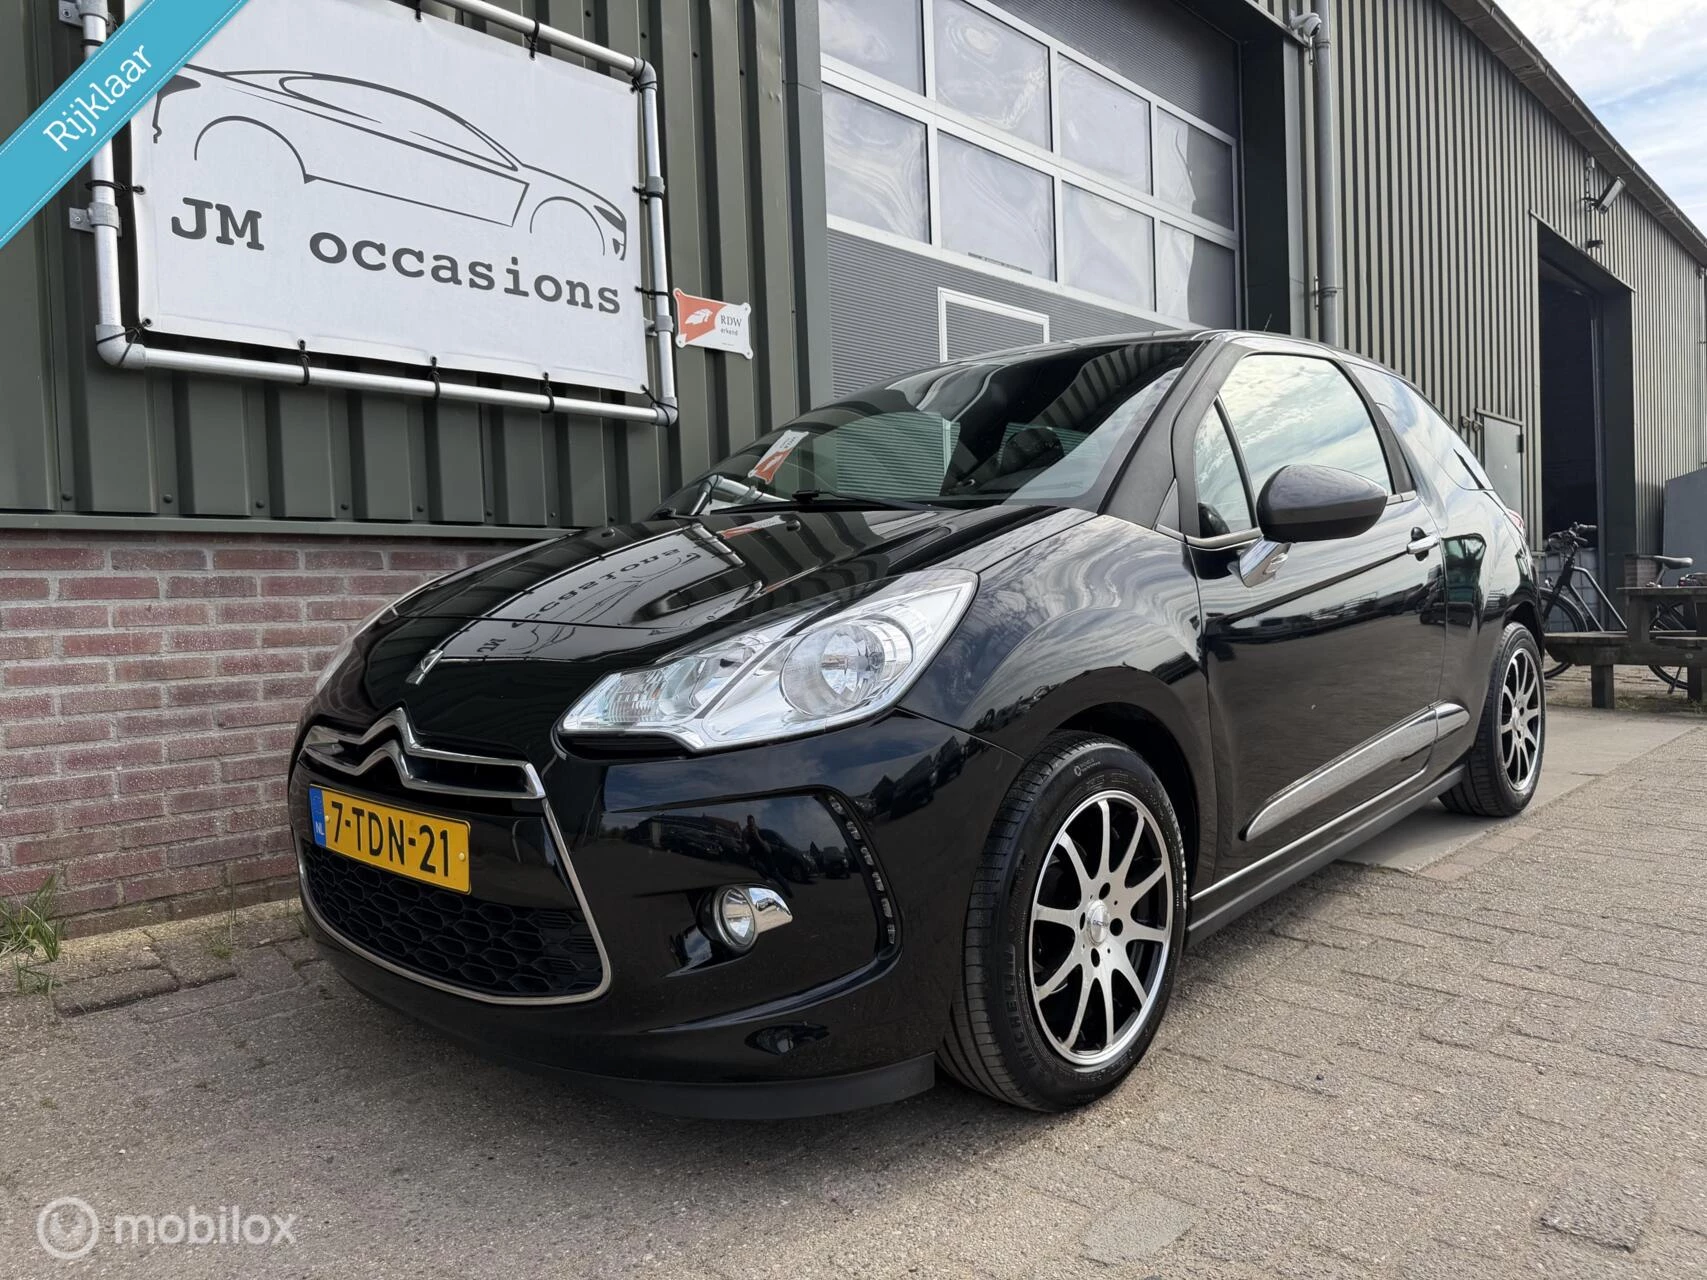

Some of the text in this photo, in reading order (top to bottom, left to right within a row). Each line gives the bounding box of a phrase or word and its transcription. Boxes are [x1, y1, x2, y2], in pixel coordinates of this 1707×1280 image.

[170, 196, 622, 316] JM occasions
[720, 314, 743, 328] RDW
[315, 821, 325, 836] NL
[331, 800, 449, 878] 7-TDN-21
